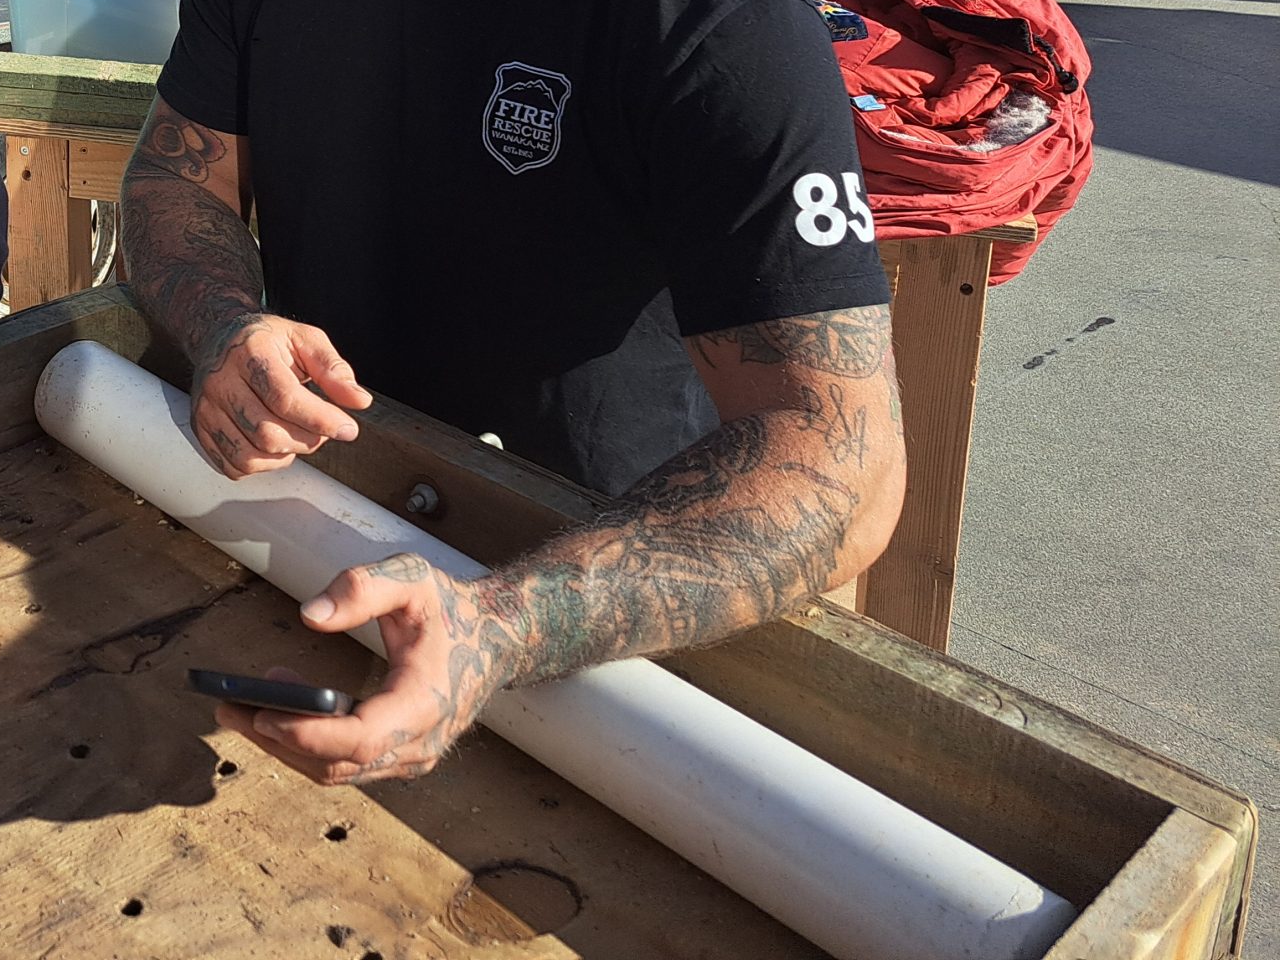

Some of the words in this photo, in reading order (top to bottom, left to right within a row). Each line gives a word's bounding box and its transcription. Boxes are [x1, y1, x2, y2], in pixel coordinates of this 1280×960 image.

[491, 117, 552, 143] RESCUE
[494, 98, 556, 130] FIRE
[792, 172, 875, 247] 85
